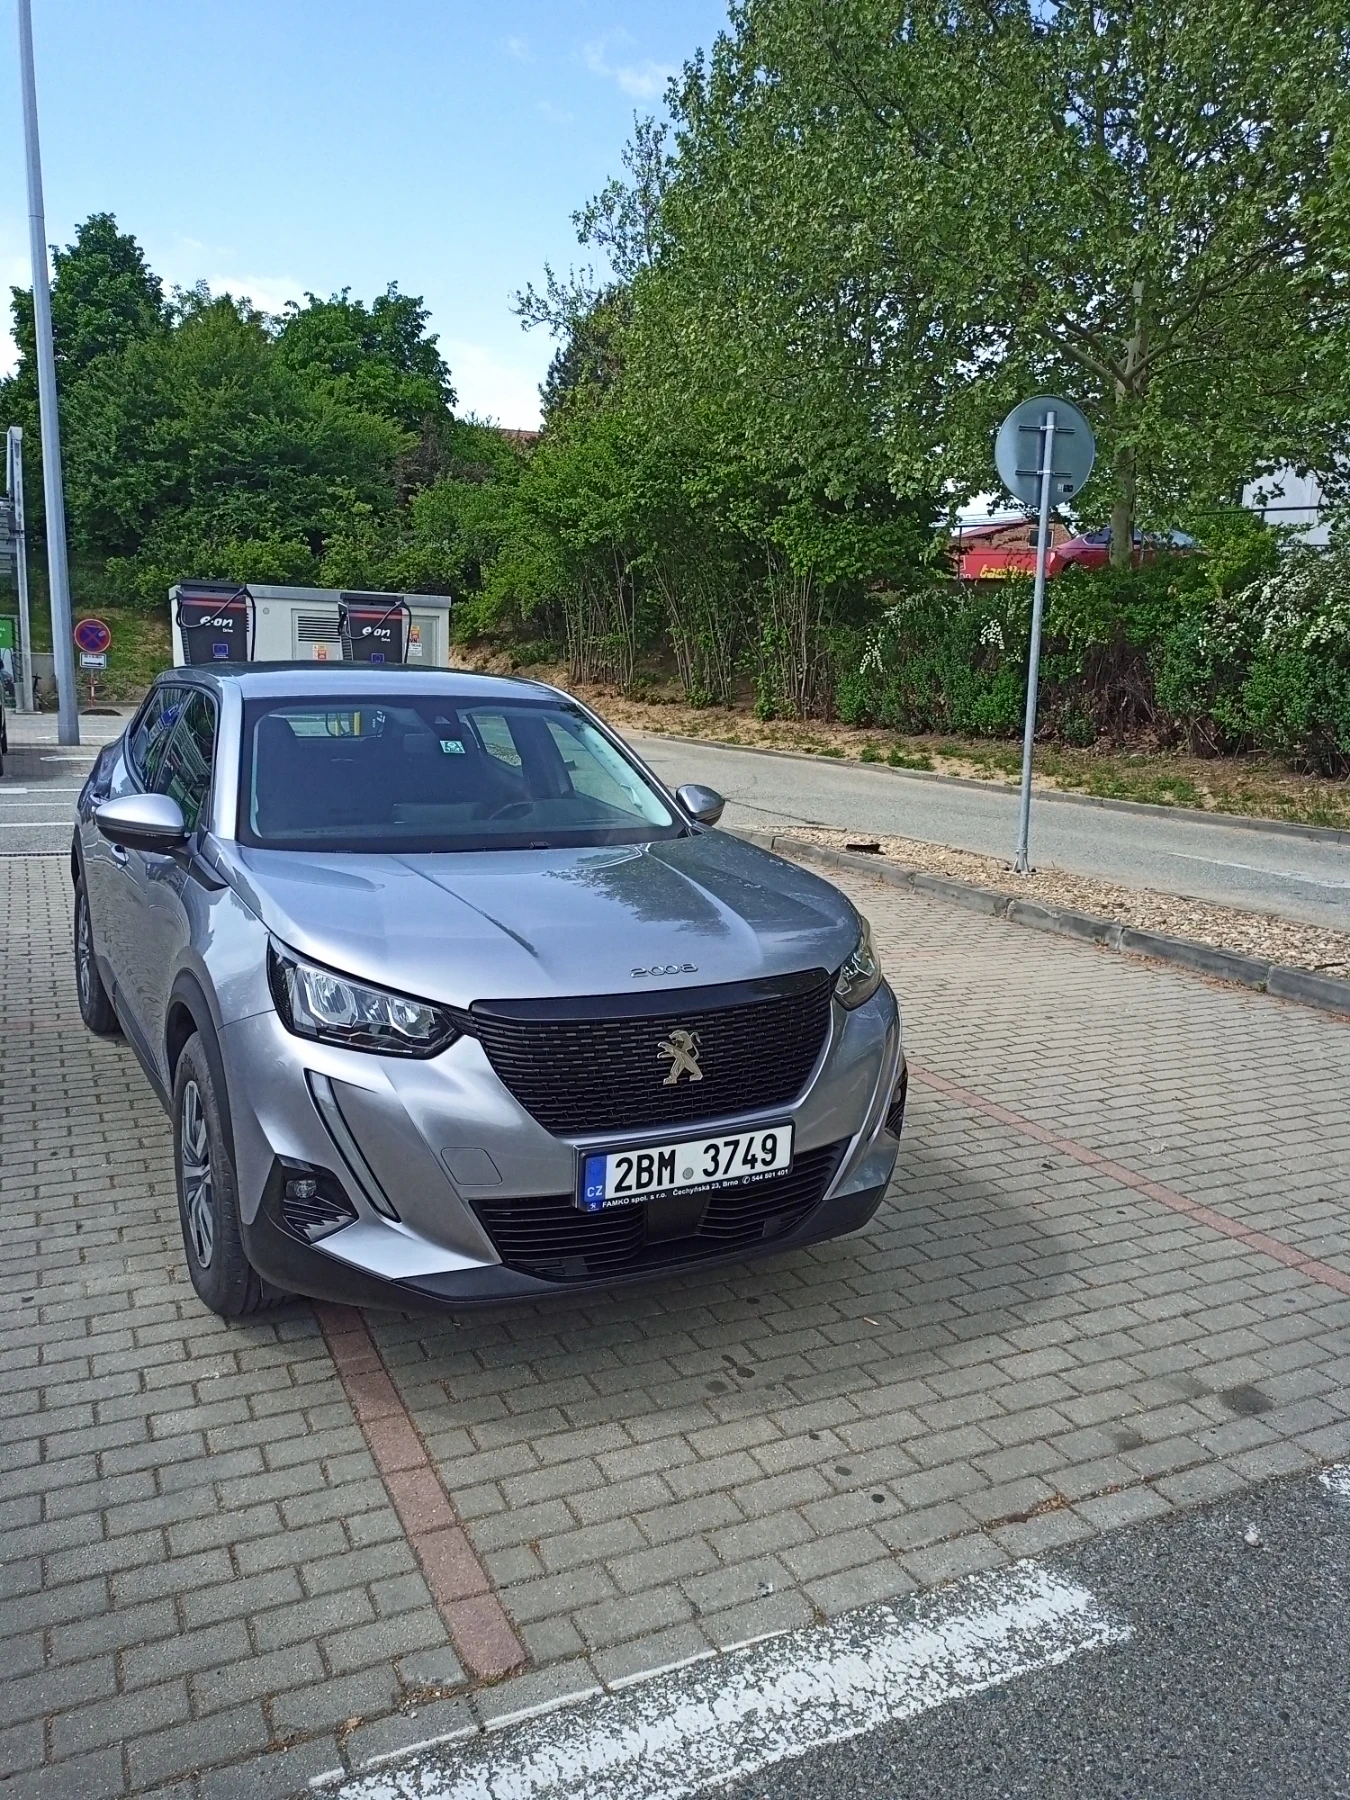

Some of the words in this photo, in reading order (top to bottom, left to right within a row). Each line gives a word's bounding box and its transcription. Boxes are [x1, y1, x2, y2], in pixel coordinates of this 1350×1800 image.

[630, 963, 698, 978] 2008
[614, 1149, 676, 1193] 2BM
[702, 1133, 777, 1177] 3749
[587, 1185, 603, 1197] CZ
[602, 1198, 629, 1208] FAMKO
[631, 1195, 648, 1203] spol.
[722, 1179, 739, 1187] Brno
[751, 1174, 763, 1182] 544
